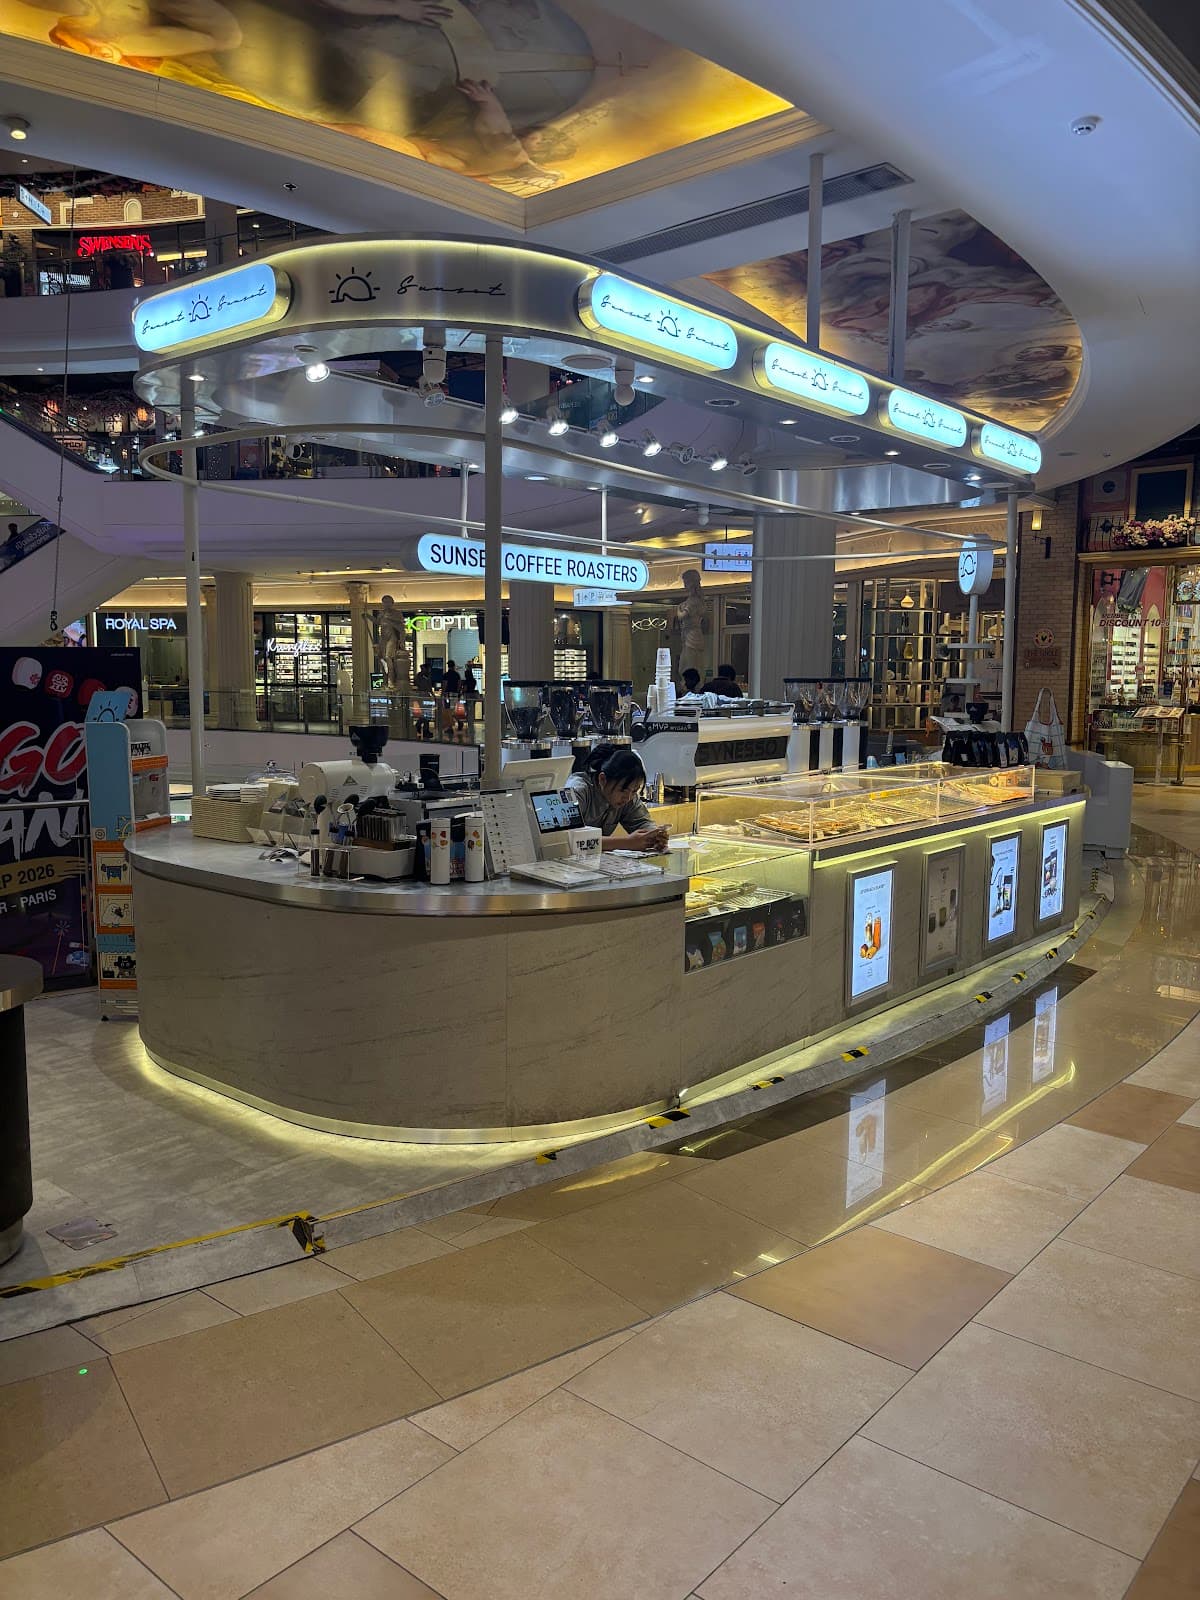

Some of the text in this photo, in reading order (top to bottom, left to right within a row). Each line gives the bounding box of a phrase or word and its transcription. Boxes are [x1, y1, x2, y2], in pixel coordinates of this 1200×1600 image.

[397, 275, 506, 295] Sunset
[142, 284, 268, 335] Sunset Sunset
[600, 295, 730, 351] Sunset Sunset
[772, 359, 865, 400] Sunset Sunset
[430, 543, 638, 583] SUNSE COFFEE ROASTERS
[105, 618, 177, 630] ROYAL SPA
[1099, 619, 1149, 628] DISCOUNT
[17, 863, 55, 885] 2026
[20, 889, 57, 908] PARIS
